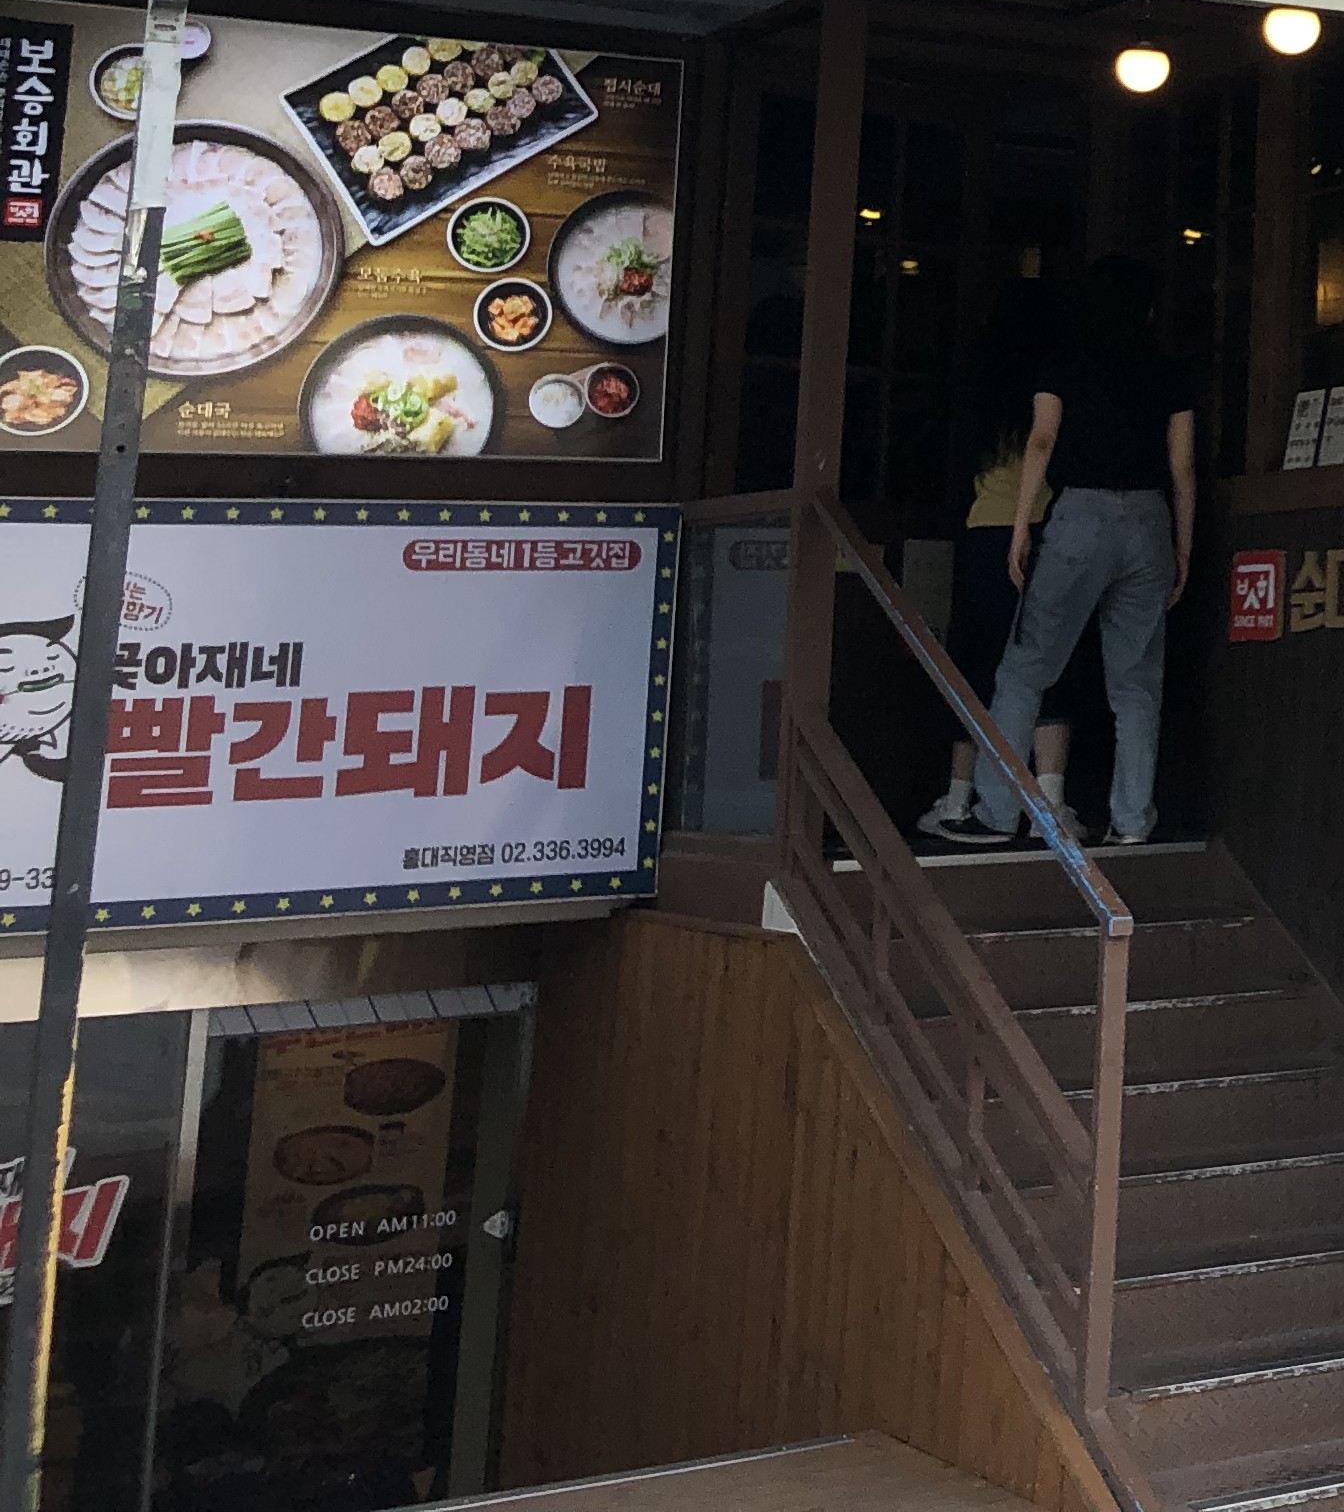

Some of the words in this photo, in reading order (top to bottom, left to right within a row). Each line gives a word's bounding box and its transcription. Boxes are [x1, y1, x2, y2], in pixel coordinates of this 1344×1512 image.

[7, 38, 56, 194] 보승회관
[178, 400, 232, 419] 순대국
[104, 684, 594, 809] 빨간돼지
[402, 842, 496, 870] 홍대직영점
[501, 836, 626, 865] 02.336.3994
[309, 1219, 366, 1242] OPEN
[376, 1209, 458, 1235] AM11:00
[305, 1261, 362, 1287] CLOSE
[374, 1251, 454, 1277] PM24:00
[301, 1304, 358, 1330] CLOSE
[368, 1294, 450, 1322] AM02:00
